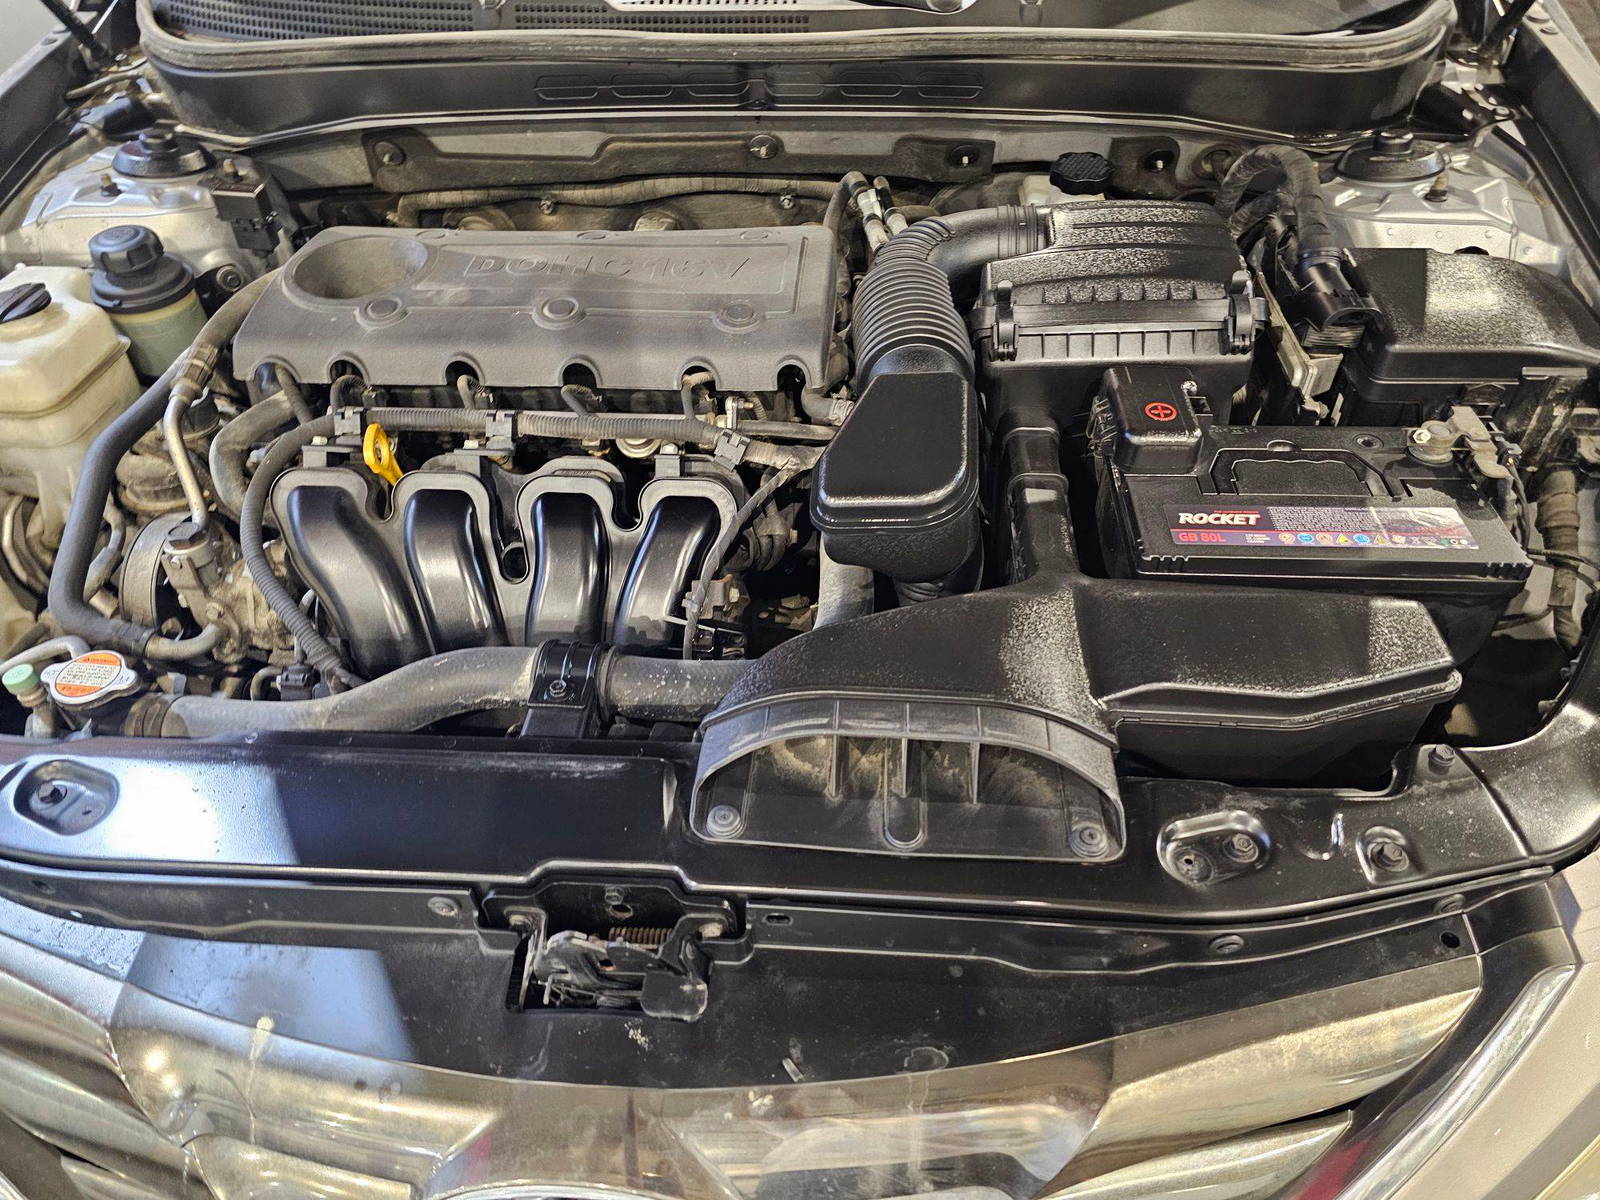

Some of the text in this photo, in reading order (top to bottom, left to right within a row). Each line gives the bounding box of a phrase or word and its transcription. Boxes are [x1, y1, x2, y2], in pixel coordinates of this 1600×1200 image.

[463, 255, 752, 280] DOHC 16V
[1178, 512, 1260, 526] ROCKET
[1178, 532, 1199, 542] GB
